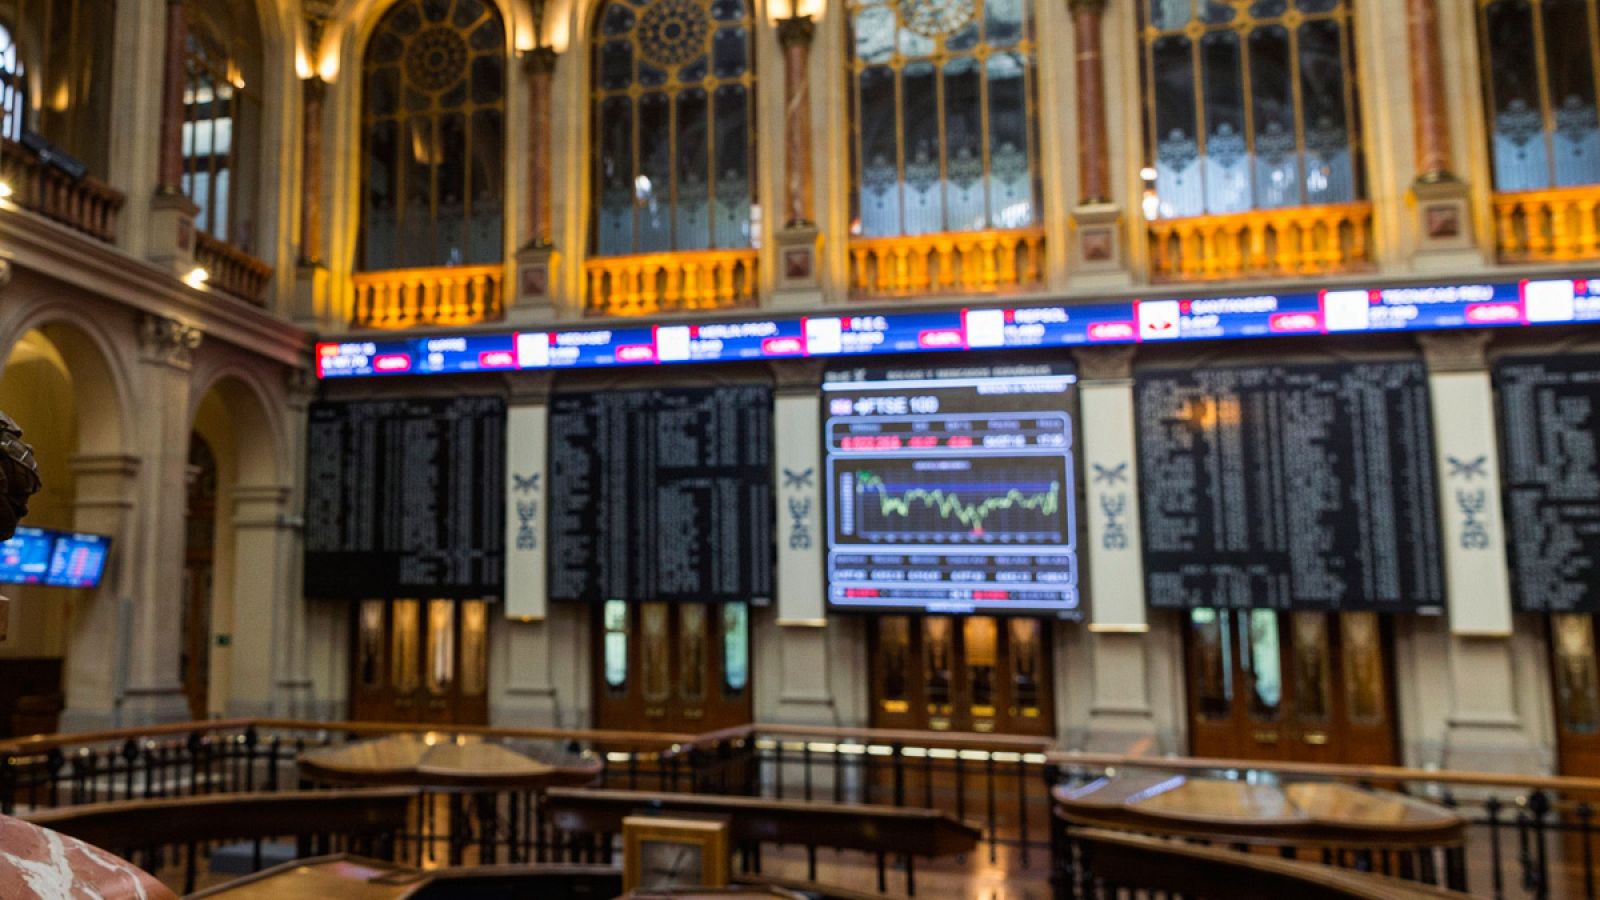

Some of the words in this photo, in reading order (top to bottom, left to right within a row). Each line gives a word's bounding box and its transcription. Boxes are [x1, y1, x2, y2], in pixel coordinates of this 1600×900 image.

[1191, 296, 1277, 314] SANTANDER
[867, 396, 908, 415] FTSE
[910, 396, 939, 414] 100
[788, 496, 811, 550] BME
[1101, 493, 1127, 549] BME
[1456, 487, 1488, 549] BME
